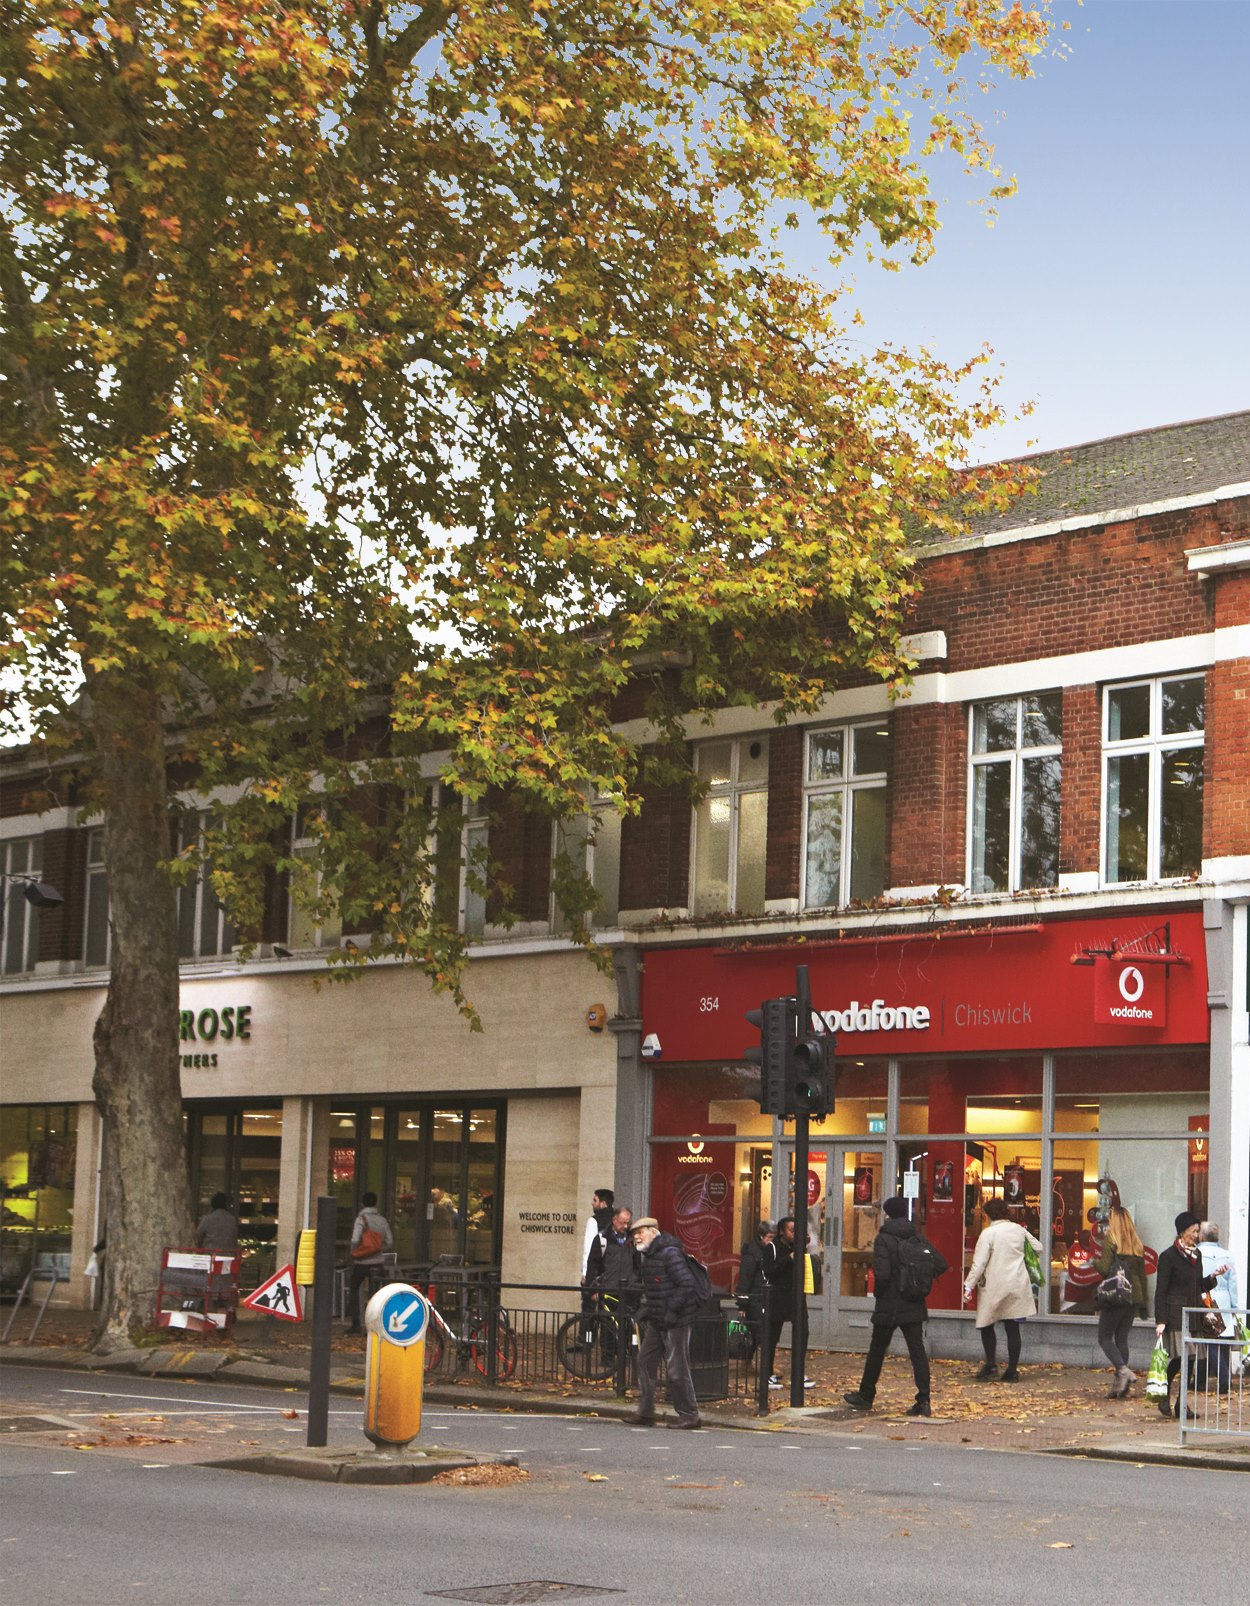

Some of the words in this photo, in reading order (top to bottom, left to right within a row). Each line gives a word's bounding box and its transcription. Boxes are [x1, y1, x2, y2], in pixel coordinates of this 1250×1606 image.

[699, 997, 719, 1012] 354
[811, 1000, 930, 1034] vodafone
[954, 1002, 1032, 1027] Chiswick
[1109, 1006, 1153, 1019] vodafone
[179, 1006, 252, 1041] ROSE
[180, 1053, 218, 1068] NERS
[678, 1155, 713, 1163] vodafone
[519, 1212, 550, 1221] WELCOME
[552, 1213, 561, 1221] TO
[562, 1213, 577, 1221] OUR
[521, 1224, 553, 1233] CHISWICK
[554, 1225, 574, 1234] STORE
